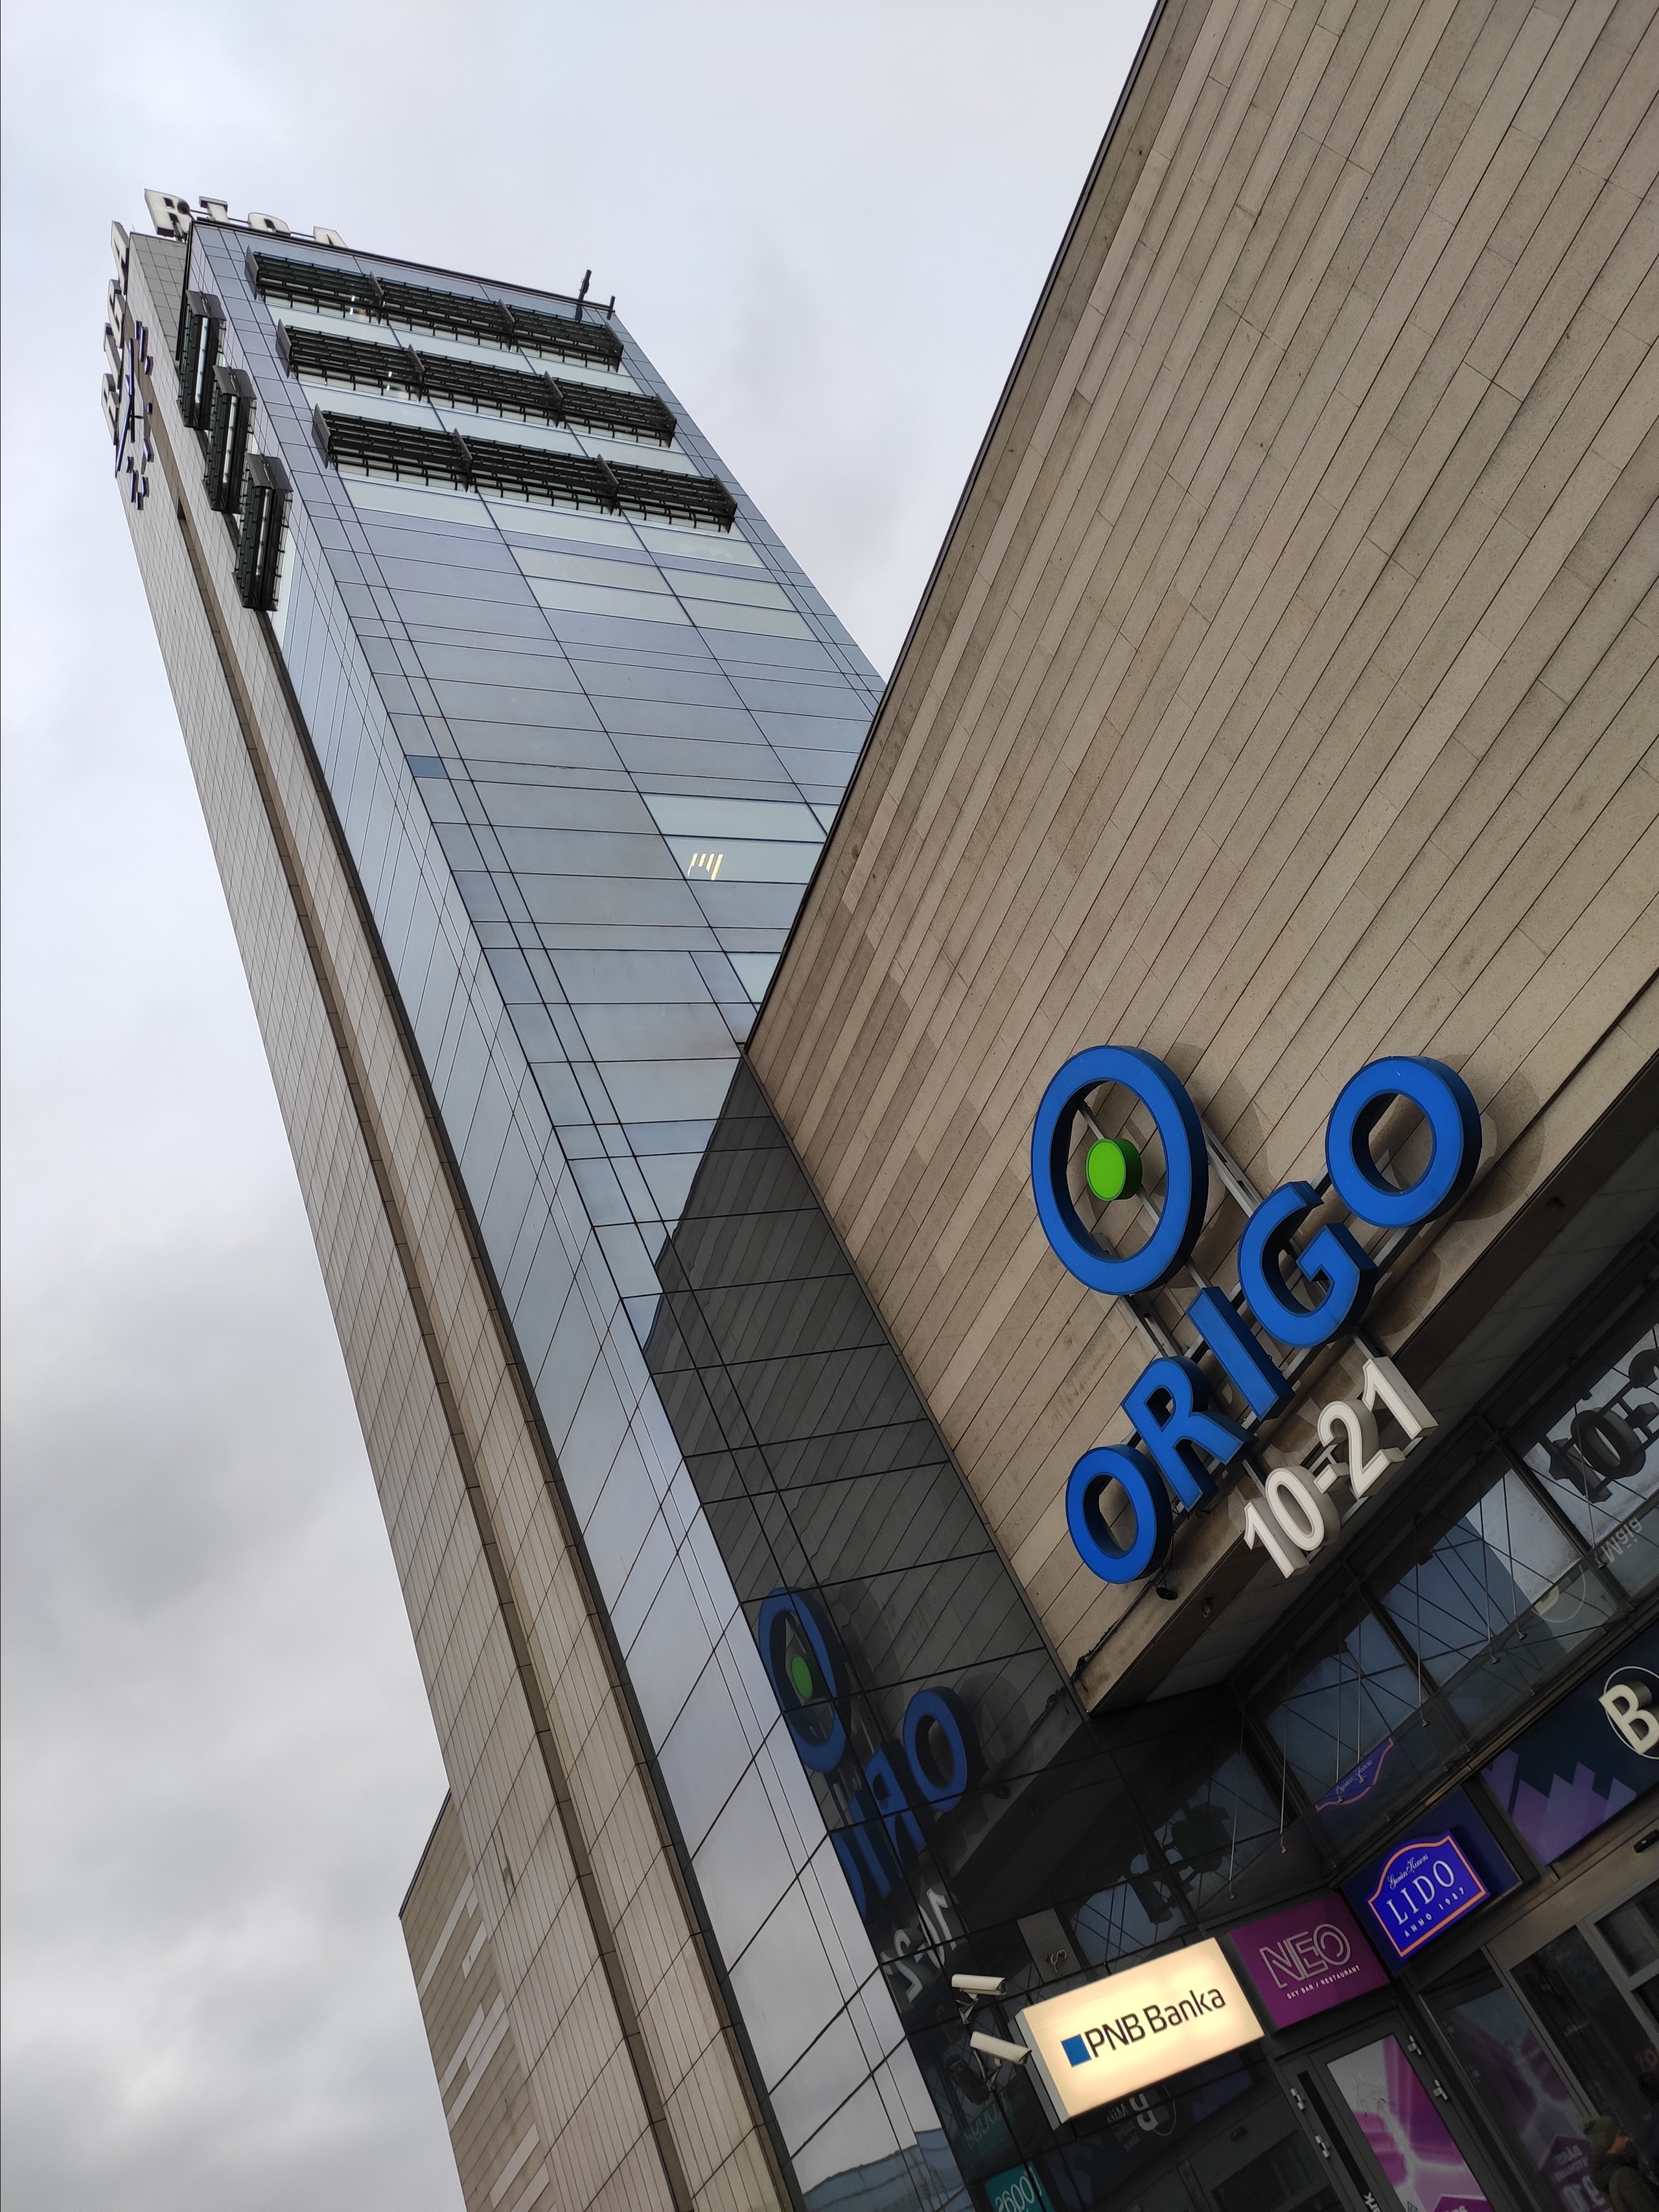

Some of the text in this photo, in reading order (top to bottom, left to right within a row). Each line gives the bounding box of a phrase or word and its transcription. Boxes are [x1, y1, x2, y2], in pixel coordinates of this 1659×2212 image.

[1065, 1056, 1482, 1585] ORIGO
[1244, 1356, 1439, 1579] 10-21
[1386, 1860, 1455, 1926] LIDO
[1404, 1887, 1465, 1938] ANNO 1987
[1259, 1924, 1352, 1989] NEO
[1286, 1990, 1299, 1999] SKY
[1301, 1984, 1314, 1994] BAR
[1320, 1965, 1360, 1985] RESTAURANT
[1084, 1988, 1226, 2058] PNB Banka
